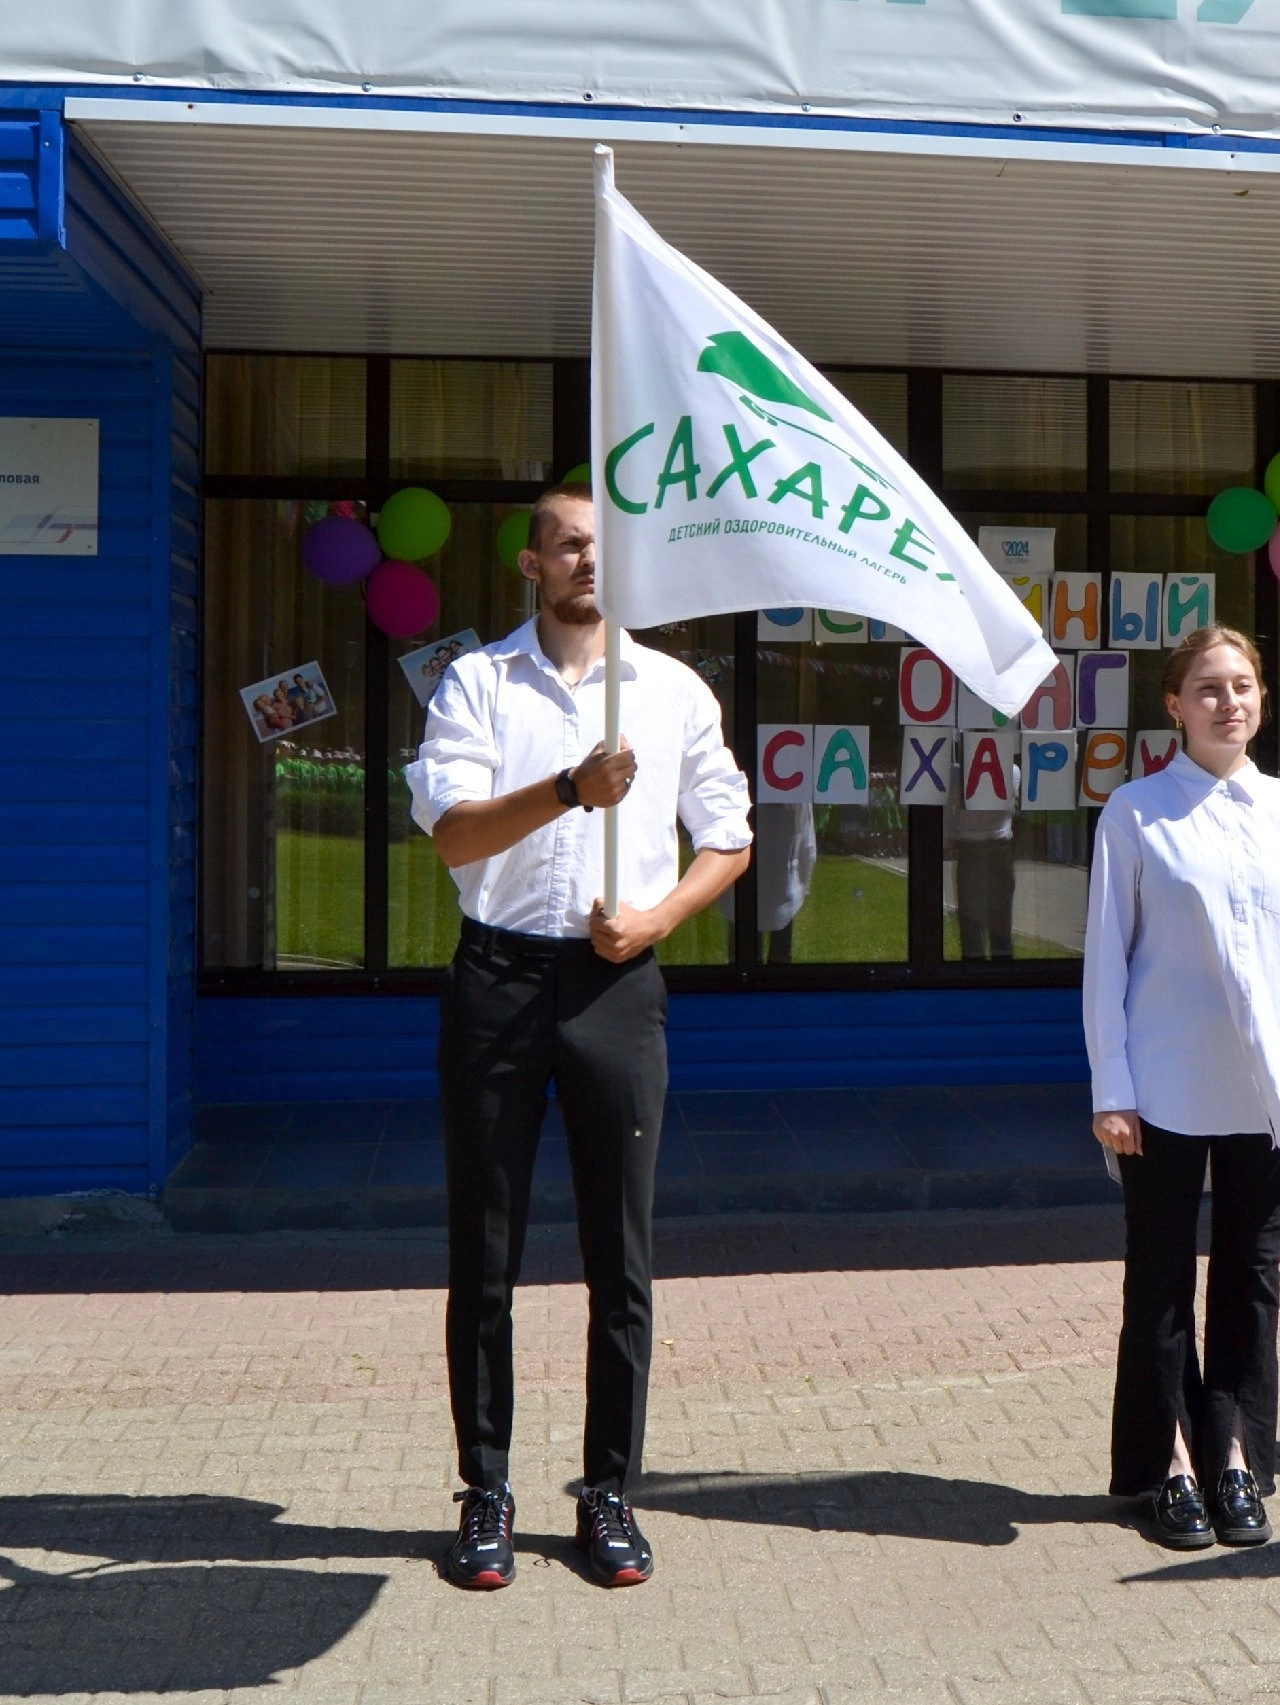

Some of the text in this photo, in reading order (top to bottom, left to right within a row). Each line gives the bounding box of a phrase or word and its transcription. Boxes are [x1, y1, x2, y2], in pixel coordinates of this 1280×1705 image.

[604, 415, 966, 597] САХАРЕ
[668, 517, 908, 585] ДЕТСКИЙ ОЗДОРОВИТЕЛЬНЫЙ ЛАГЕРЬ
[901, 649, 1127, 730] ОАГ
